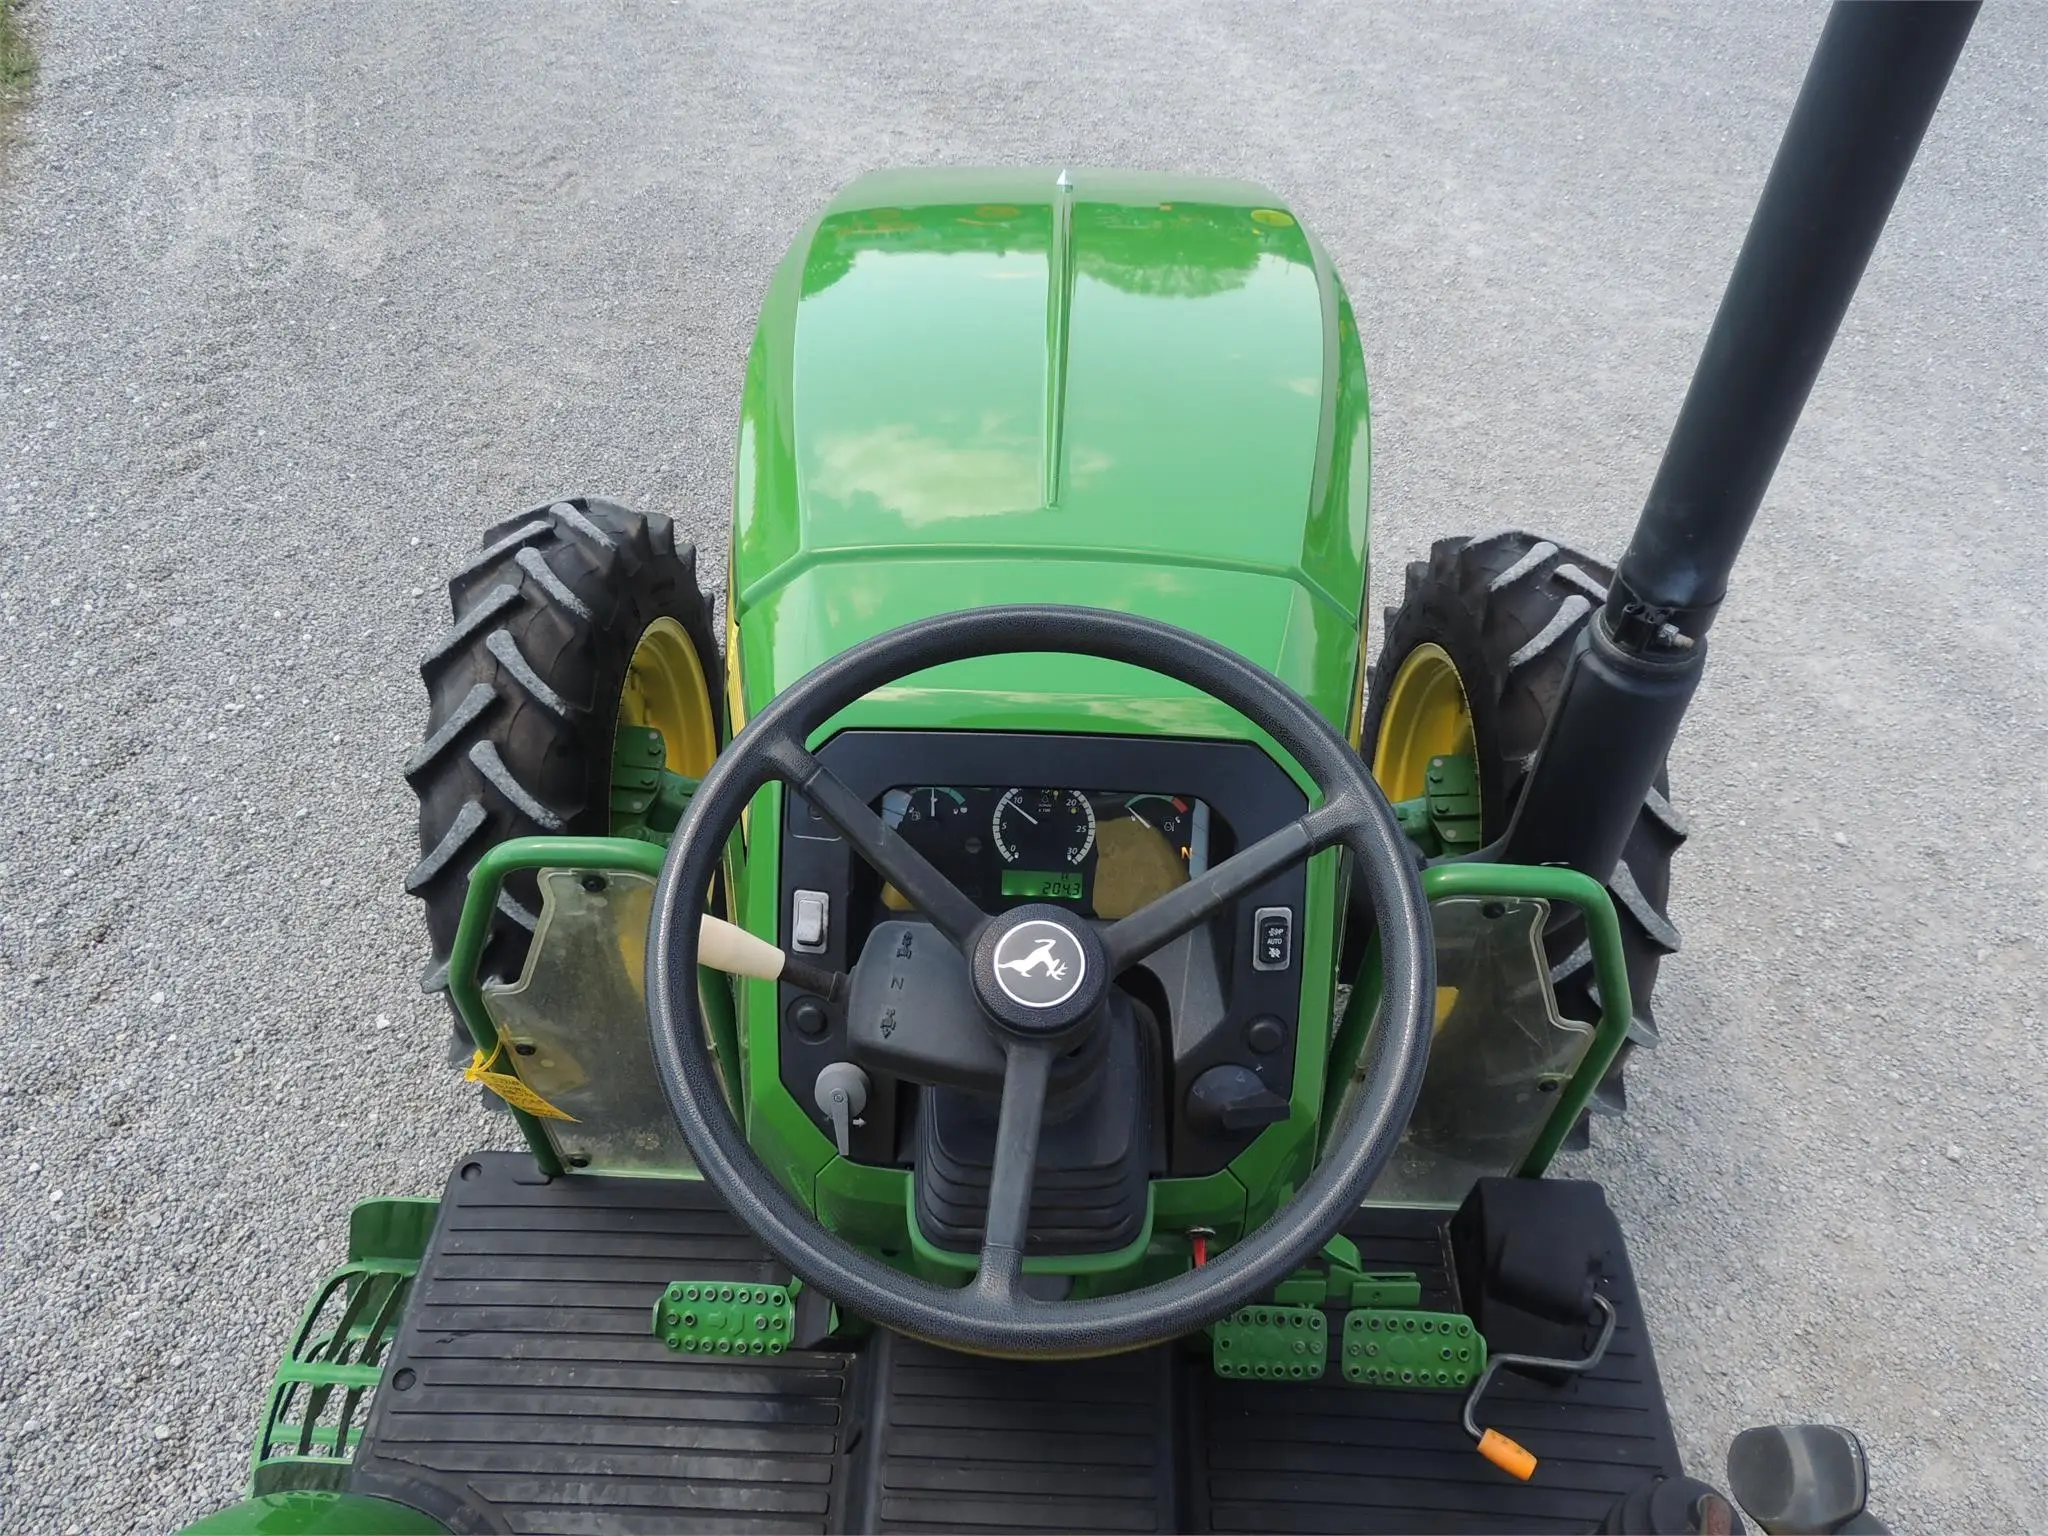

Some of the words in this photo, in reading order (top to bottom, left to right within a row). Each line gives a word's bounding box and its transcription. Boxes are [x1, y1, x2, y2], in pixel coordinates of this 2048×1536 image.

[1014, 796, 1023, 804] 10
[1076, 825, 1087, 833] 25
[1067, 847, 1078, 855] 30
[1181, 846, 1193, 859] N
[890, 976, 905, 990] N
